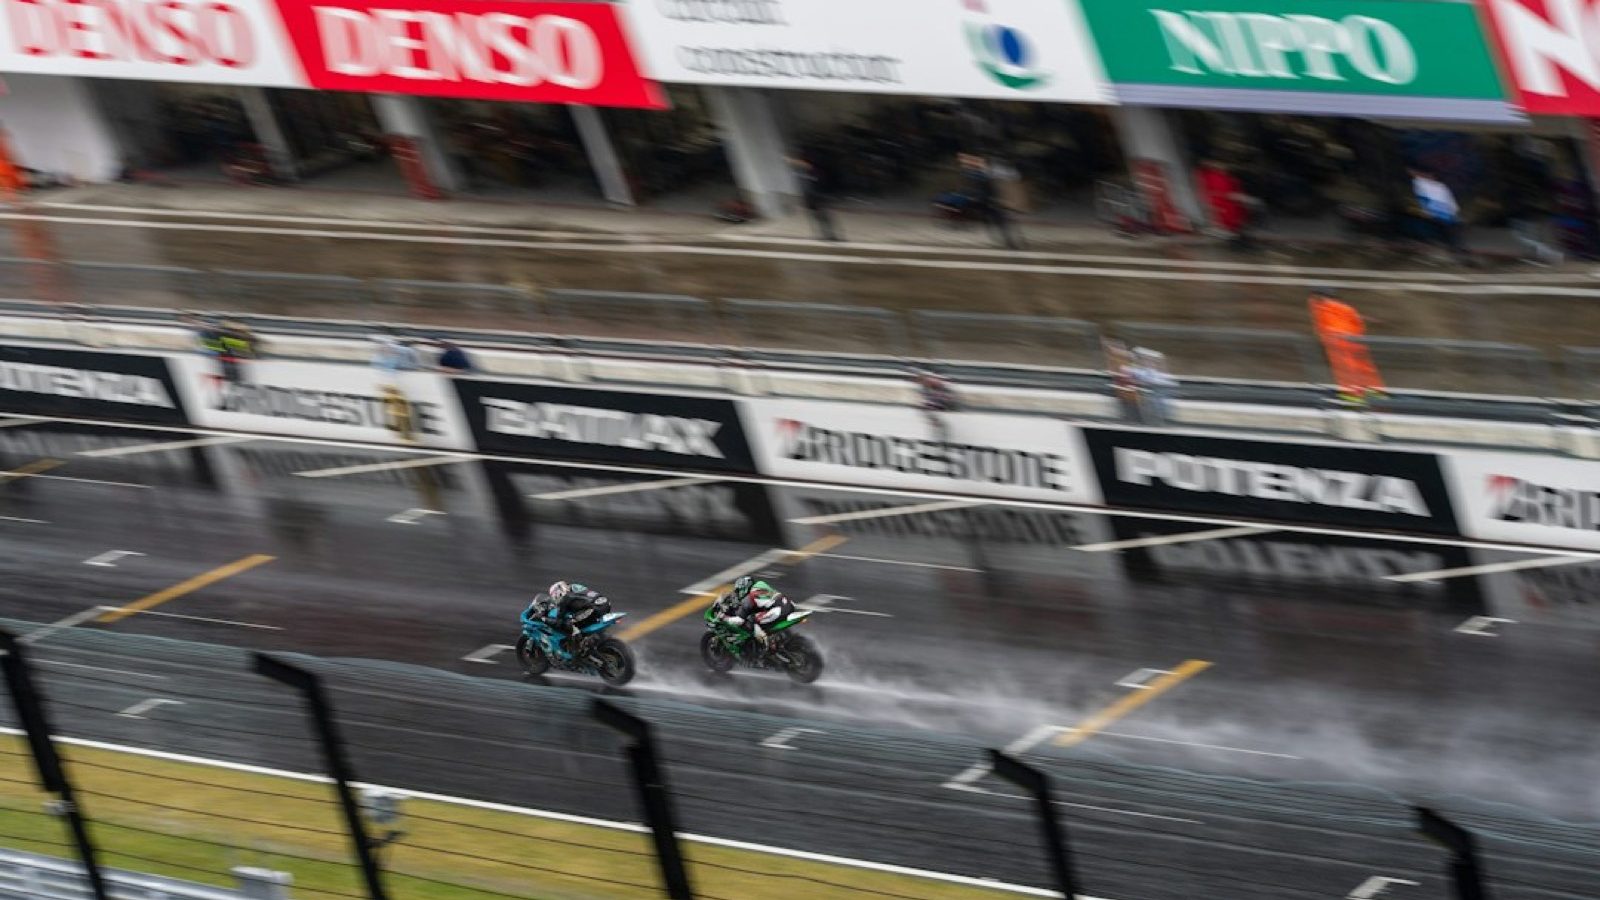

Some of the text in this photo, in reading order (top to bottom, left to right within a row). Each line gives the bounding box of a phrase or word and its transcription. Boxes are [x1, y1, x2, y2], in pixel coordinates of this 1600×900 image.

[8, 0, 257, 69] DENSO
[313, 8, 605, 91] DENSO
[1149, 8, 1419, 86] NIPPO
[202, 373, 445, 437] BRIDGESTOE
[775, 418, 1073, 492] BRIDGESTONE
[1113, 446, 1432, 517] POTENZA
